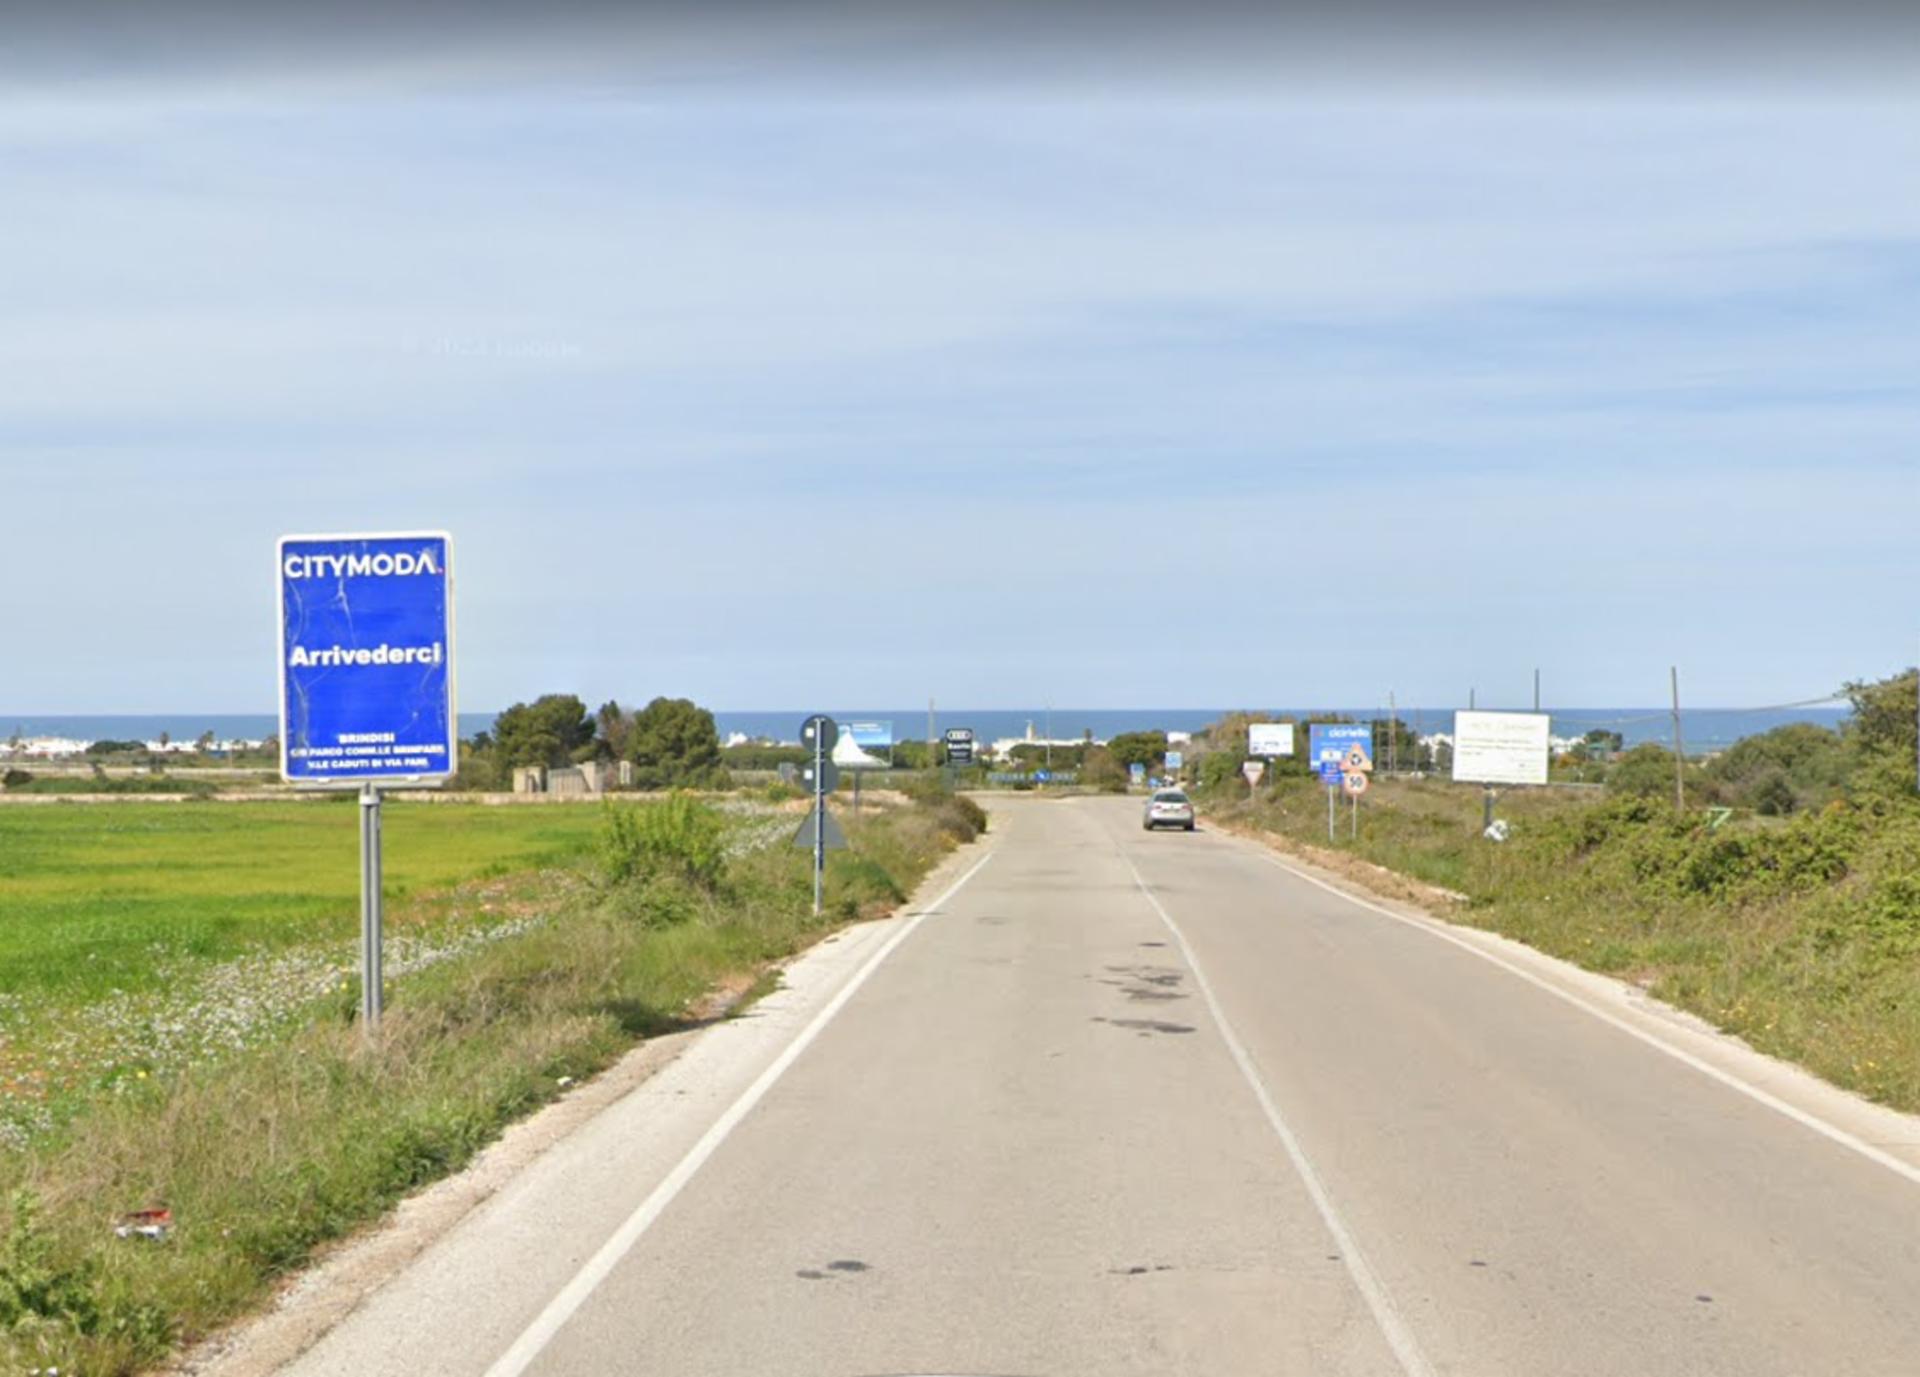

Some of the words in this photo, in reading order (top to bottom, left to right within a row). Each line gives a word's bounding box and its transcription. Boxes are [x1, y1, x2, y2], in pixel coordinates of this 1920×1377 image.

[290, 642, 441, 666] Arrivederci
[339, 733, 395, 744] BRINDISI
[309, 747, 343, 757] PARCO
[385, 758, 402, 767] VIA
[1350, 776, 1363, 788] 50
